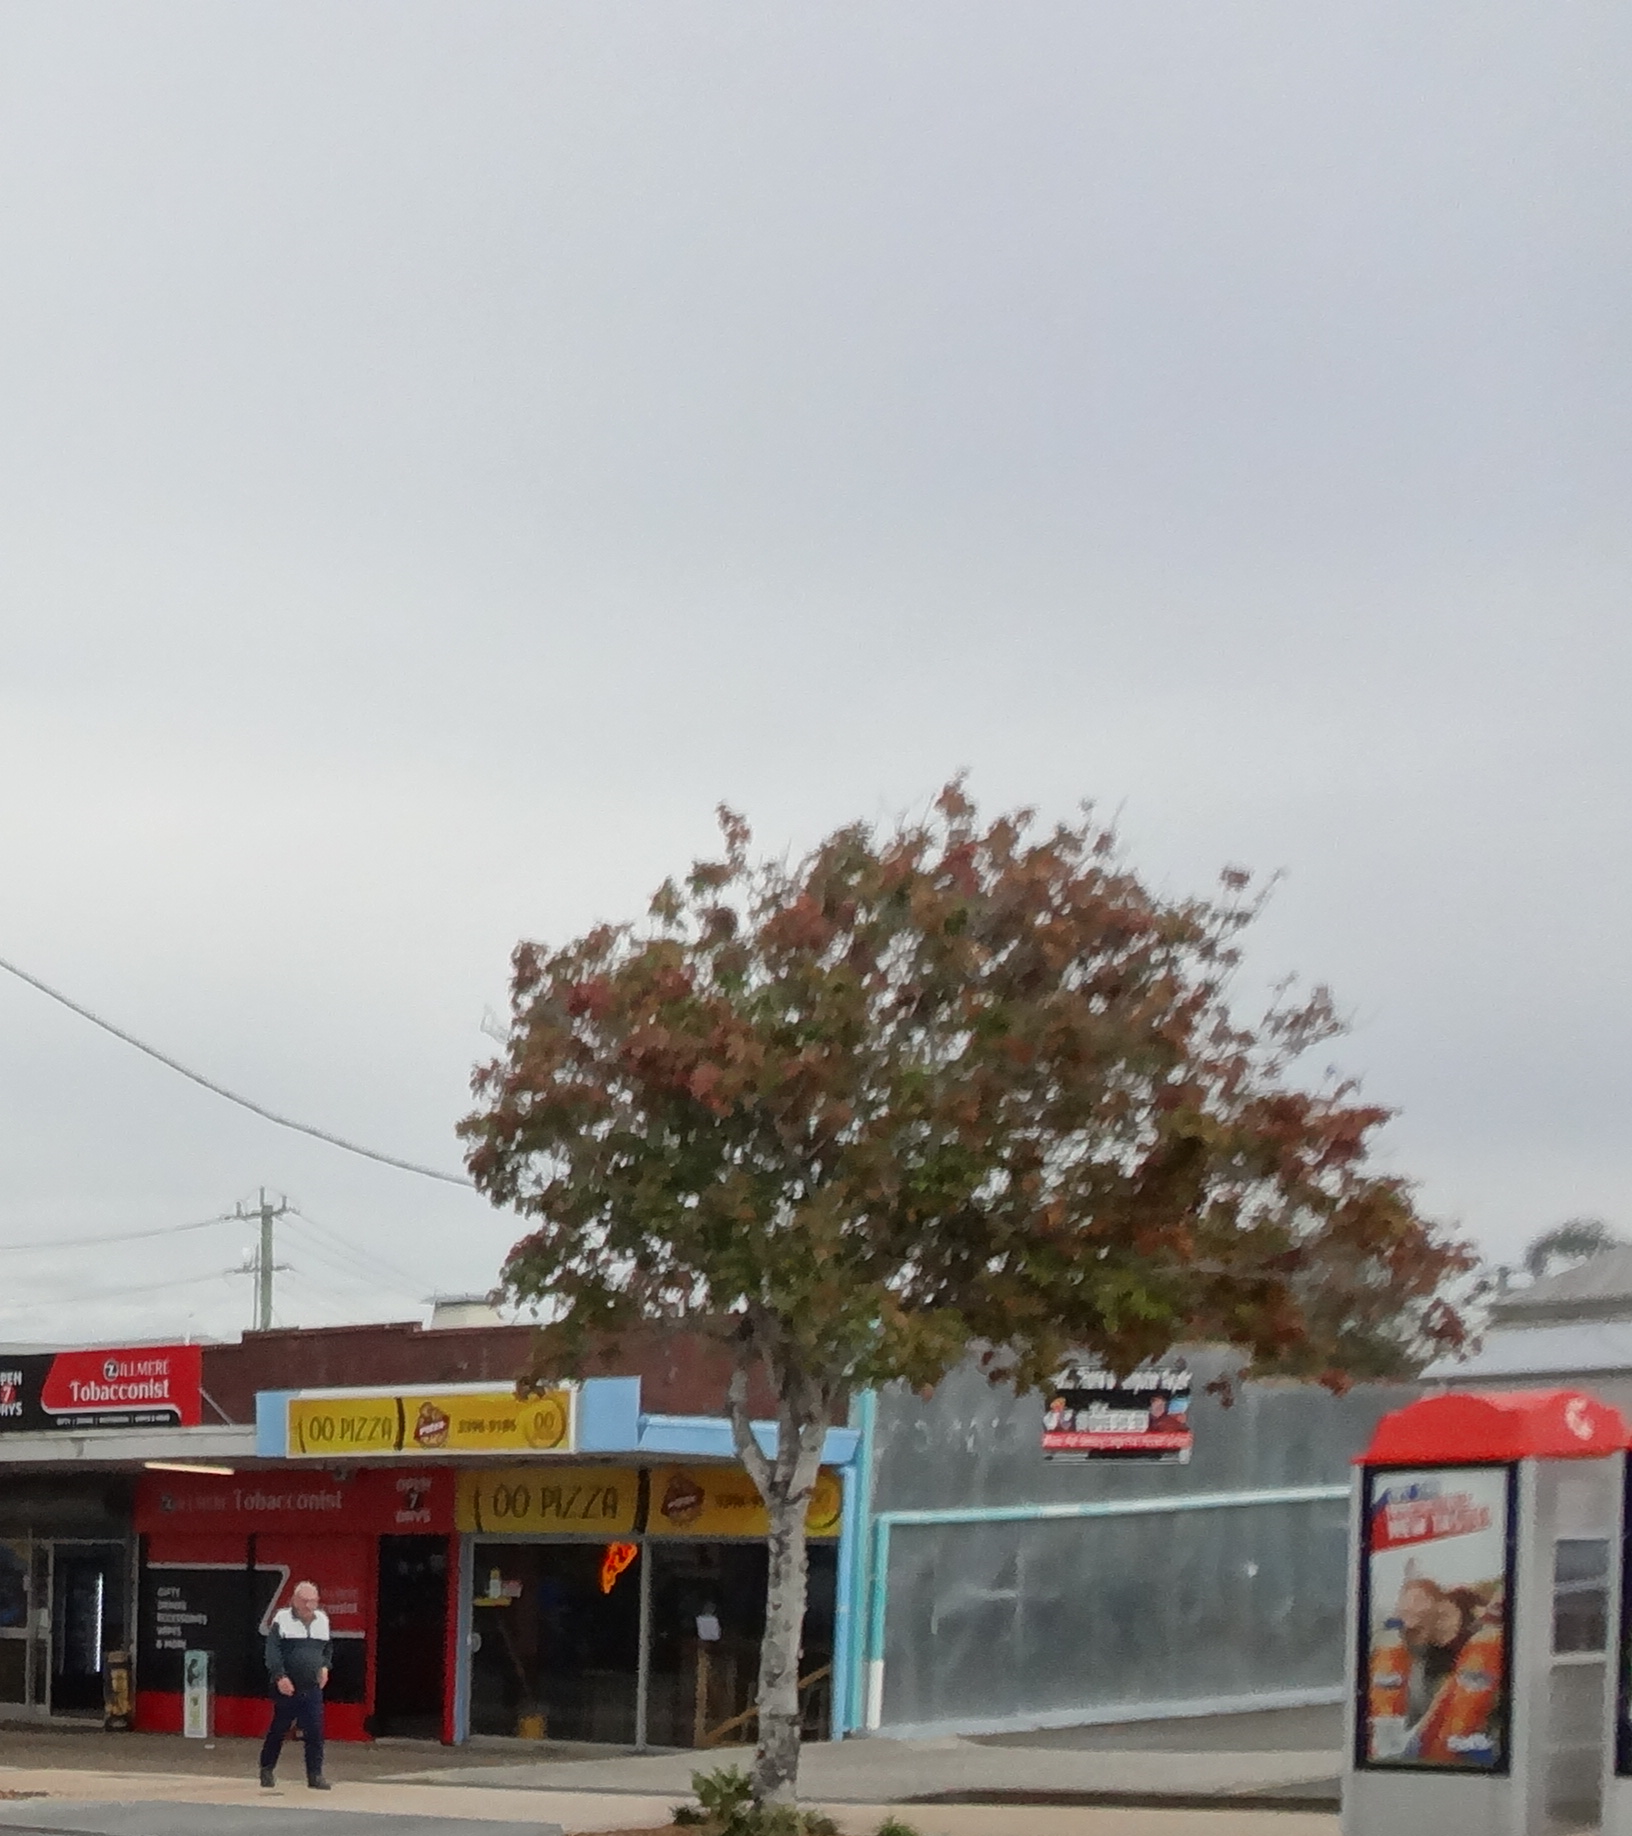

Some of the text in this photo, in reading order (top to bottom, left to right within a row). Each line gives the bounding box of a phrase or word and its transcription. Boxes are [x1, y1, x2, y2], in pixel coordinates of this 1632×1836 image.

[103, 1358, 171, 1381] ZILLMERE
[2, 1387, 11, 1402] 7
[69, 1378, 171, 1402] Tobacconist
[339, 1416, 392, 1441] PIZZA
[540, 1485, 619, 1519] PIZZA
